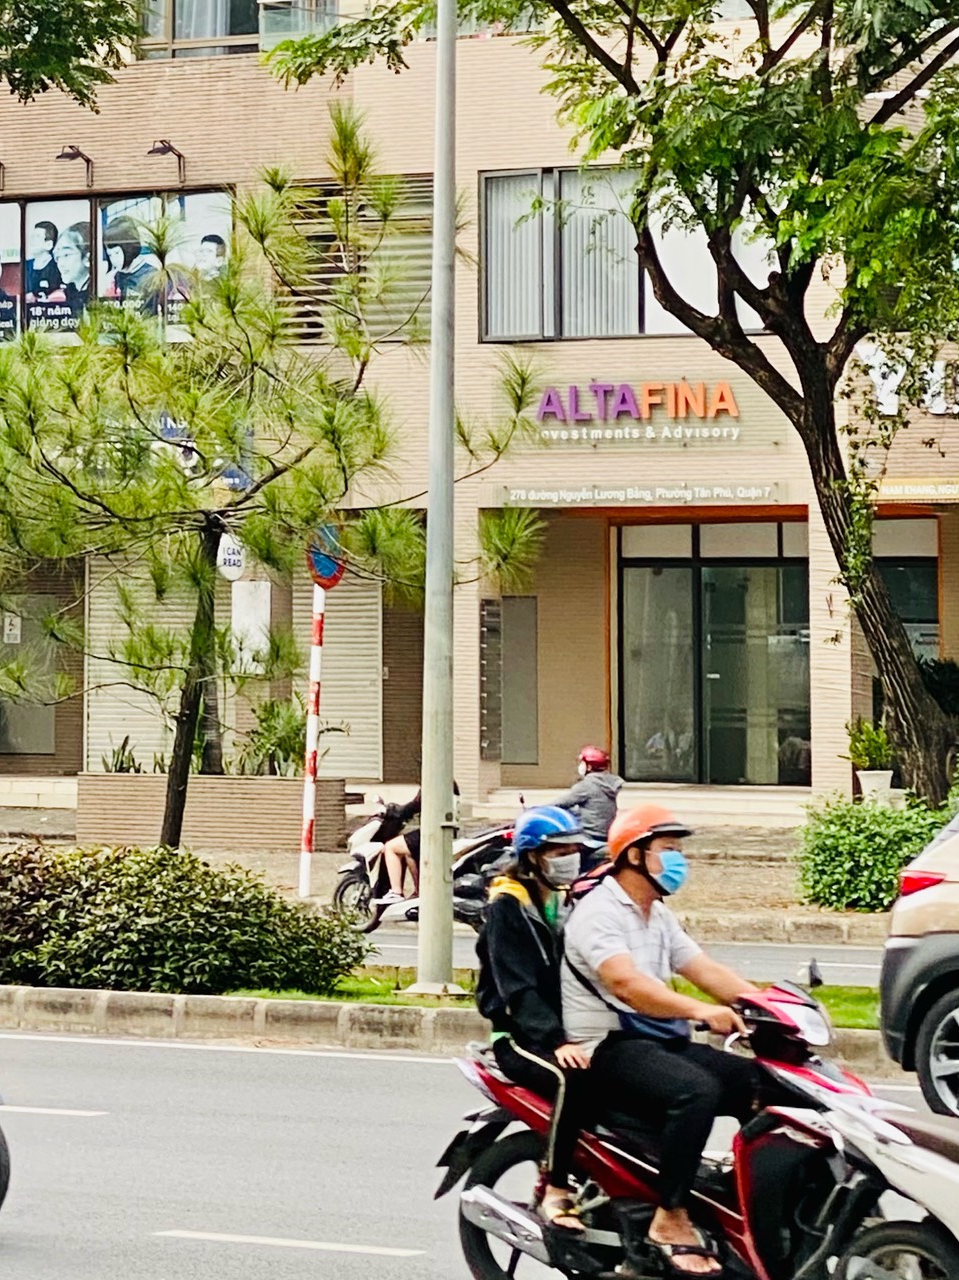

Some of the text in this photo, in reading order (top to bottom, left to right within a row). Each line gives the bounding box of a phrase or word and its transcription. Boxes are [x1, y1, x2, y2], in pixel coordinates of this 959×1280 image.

[536, 379, 739, 421] ALTAFINA
[645, 426, 655, 440] &
[661, 425, 740, 441] Advisory
[594, 489, 626, 502] Lương
[737, 486, 763, 500] Quận
[764, 486, 771, 498] 7
[227, 548, 241, 557] CAN
[222, 557, 242, 568] READ
